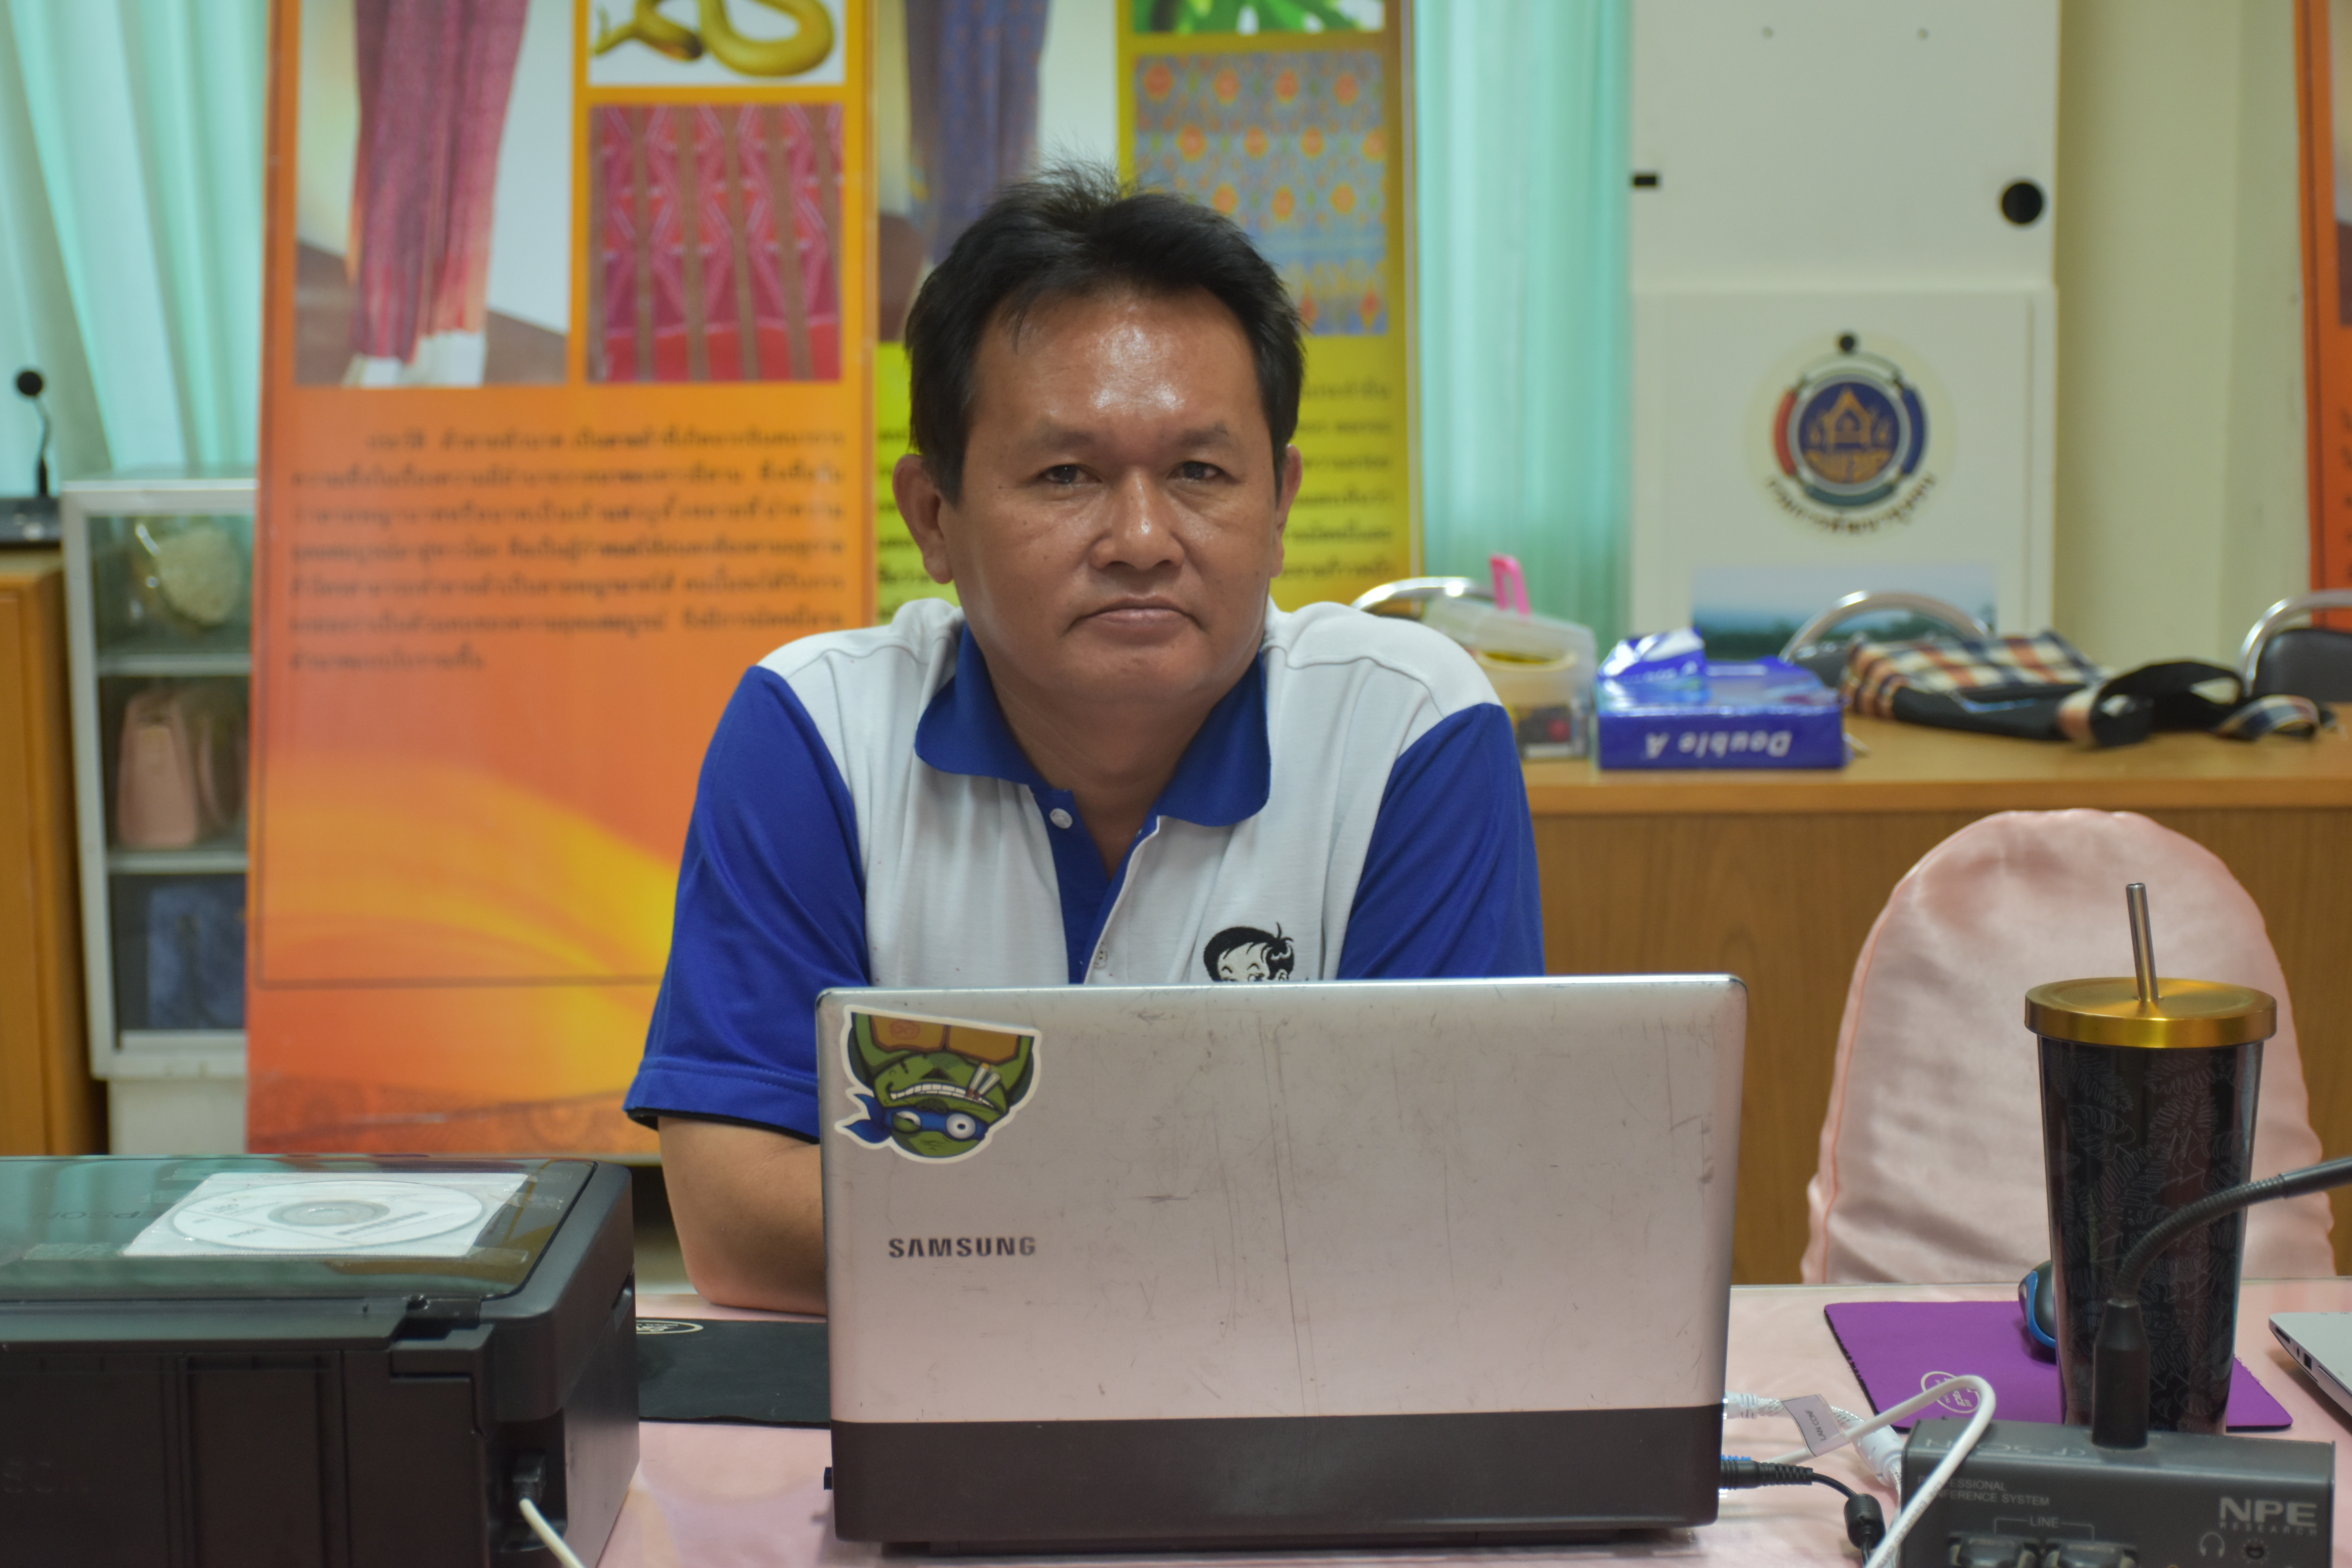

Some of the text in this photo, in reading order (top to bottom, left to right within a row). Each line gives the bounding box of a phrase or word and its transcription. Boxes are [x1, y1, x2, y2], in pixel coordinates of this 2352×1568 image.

[1645, 730, 1793, 759] Double A
[889, 1236, 1035, 1258] SAMSUNG
[1815, 1426, 1827, 1441] LAN
[1918, 1475, 2007, 1492] PESSIONAL
[1936, 1490, 2050, 1506] NFERENCE SYSTEM
[2220, 1497, 2317, 1527] NPE
[2030, 1516, 2060, 1528] LINE
[2219, 1521, 2317, 1537] RESEARCH
